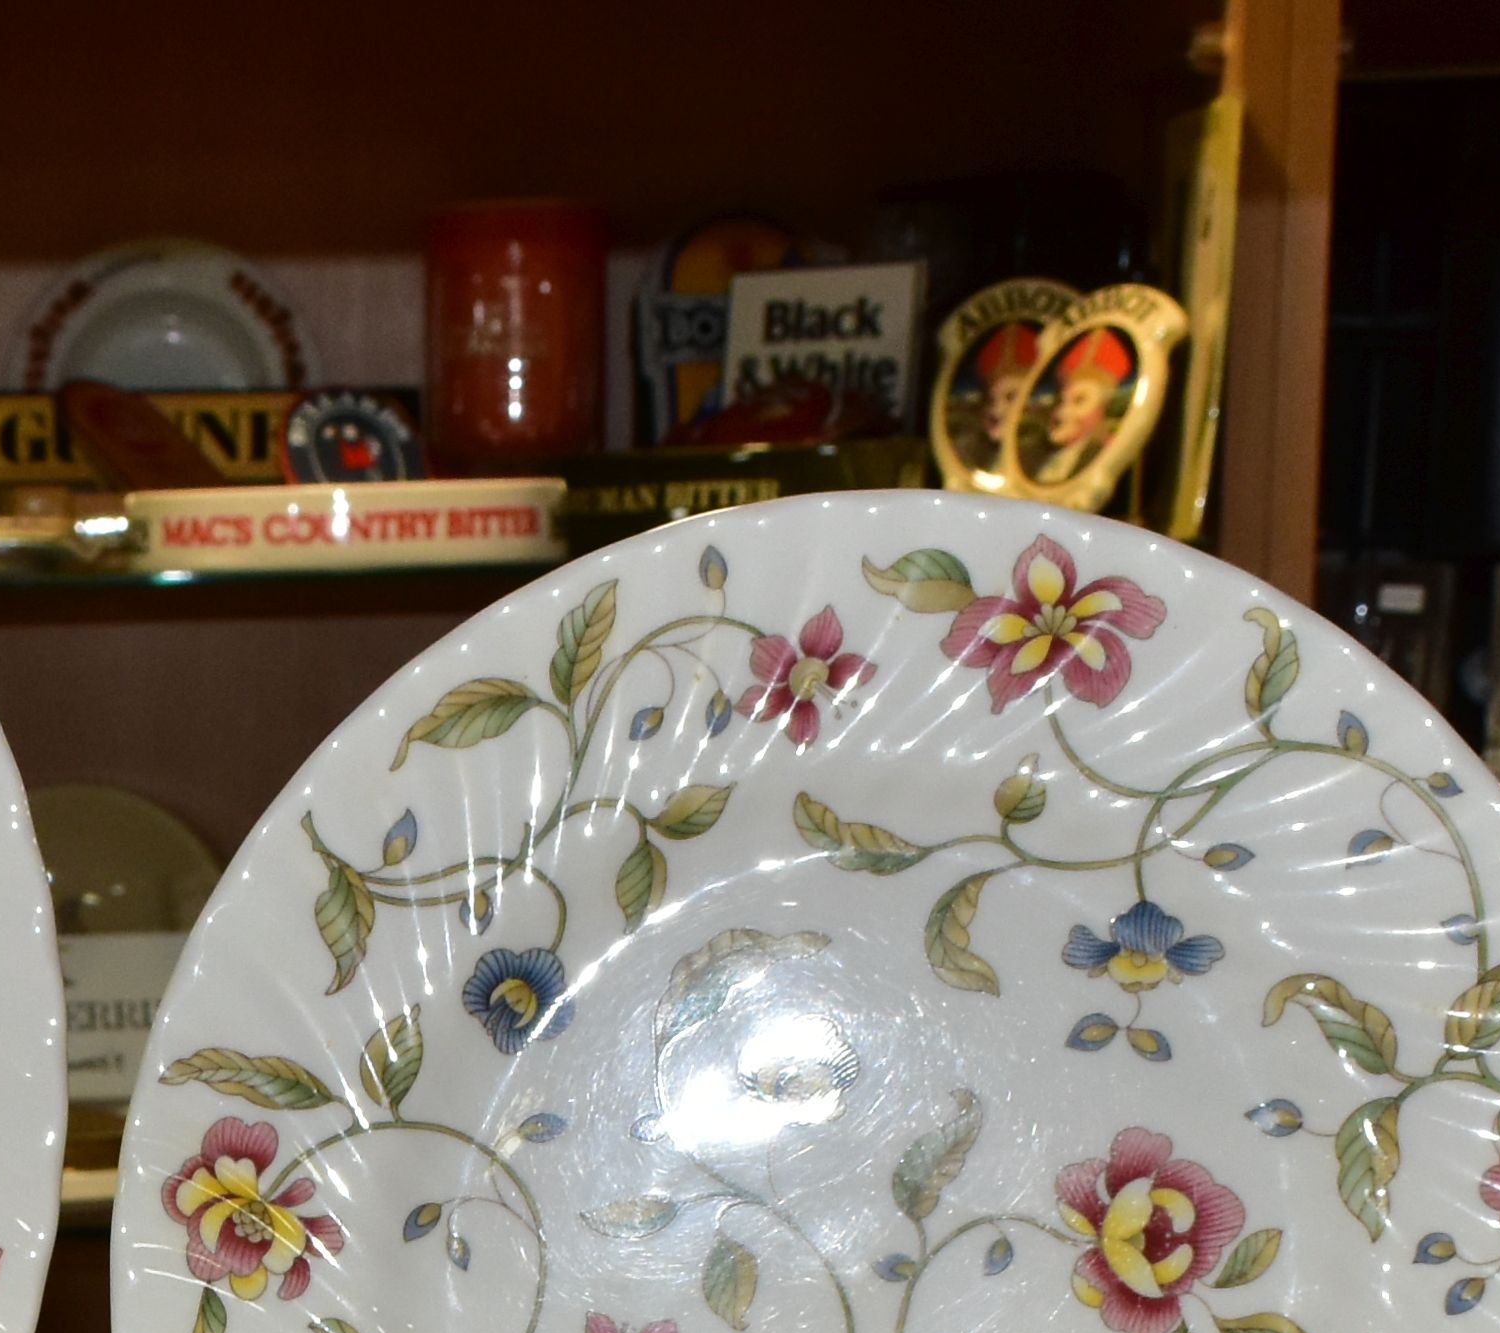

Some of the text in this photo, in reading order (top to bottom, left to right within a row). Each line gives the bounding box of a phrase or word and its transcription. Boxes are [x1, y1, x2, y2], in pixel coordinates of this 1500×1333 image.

[762, 296, 882, 342] Black
[769, 347, 897, 393] White
[263, 509, 440, 545] COUNTRY
[447, 506, 540, 539] BITTER
